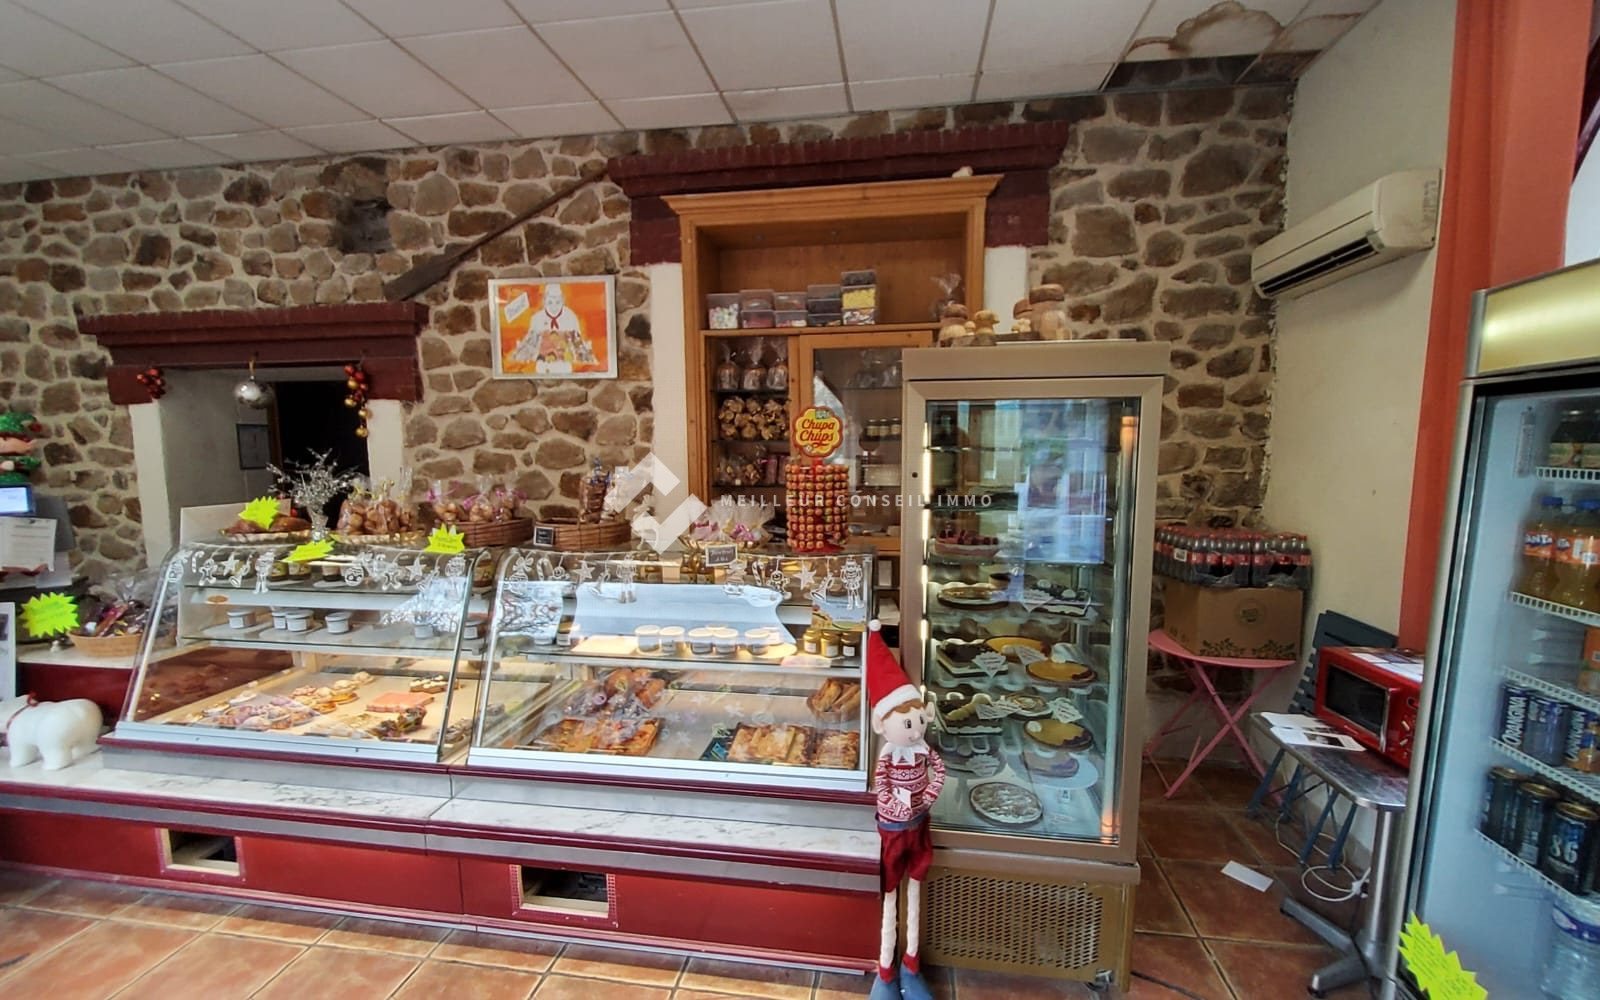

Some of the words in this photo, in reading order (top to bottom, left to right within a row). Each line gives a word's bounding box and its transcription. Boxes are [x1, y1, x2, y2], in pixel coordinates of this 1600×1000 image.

[801, 419, 835, 432] Chupa
[800, 430, 834, 446] Chups
[1502, 696, 1528, 745] ORANGINA
